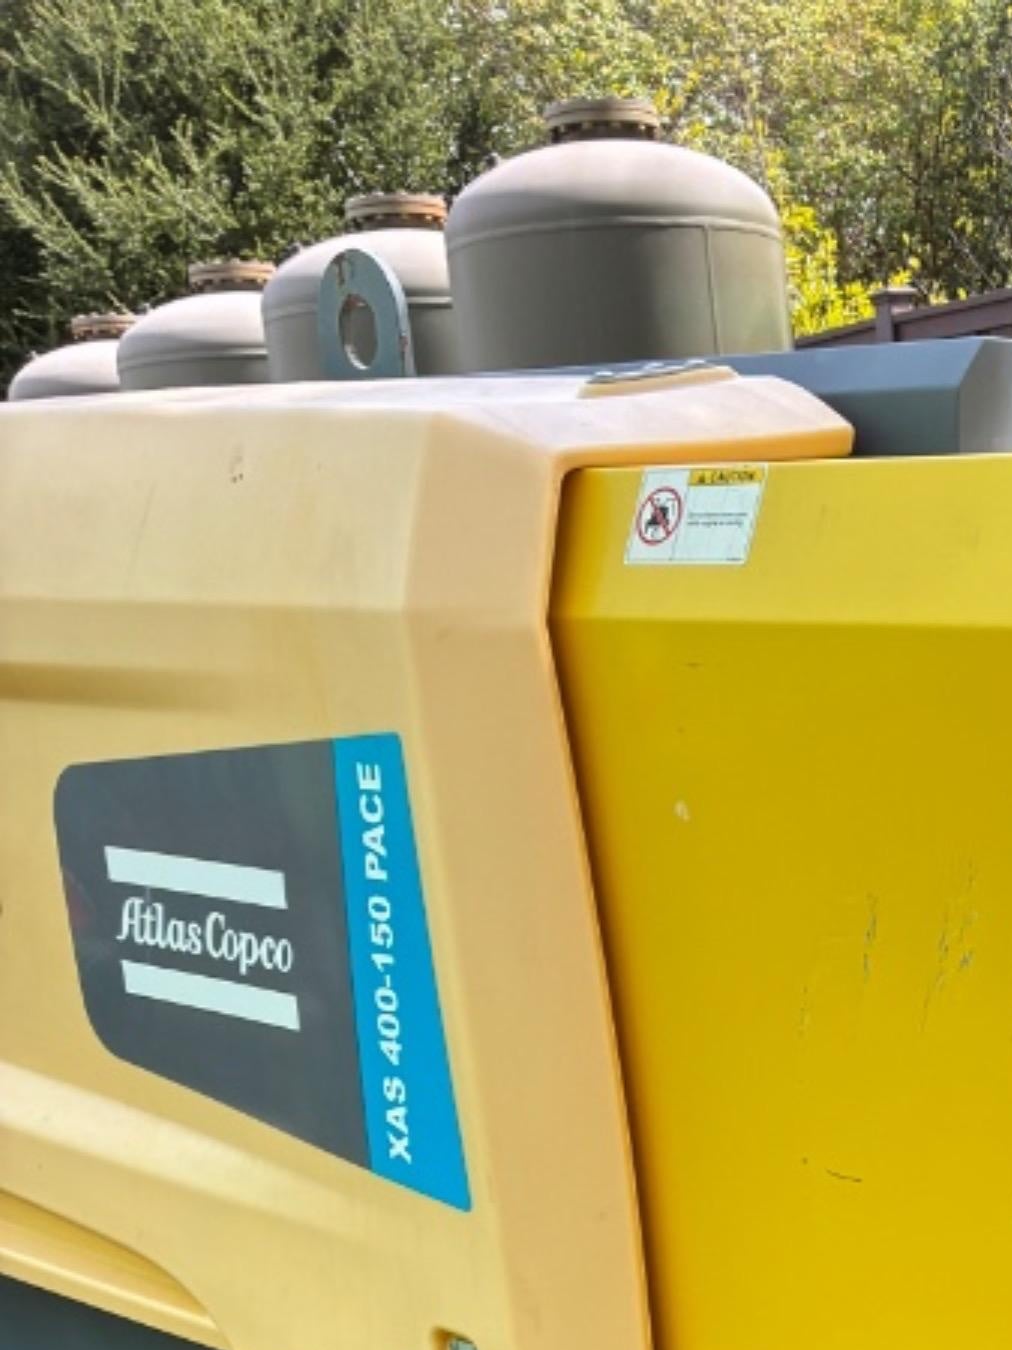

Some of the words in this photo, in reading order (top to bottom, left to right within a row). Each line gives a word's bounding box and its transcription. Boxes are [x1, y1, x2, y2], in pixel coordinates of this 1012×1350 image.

[356, 761, 388, 881] PACE
[116, 896, 201, 955] Atlas
[206, 911, 294, 976] Copco
[367, 894, 402, 1067] 400-150
[382, 1076, 412, 1165] XAS
